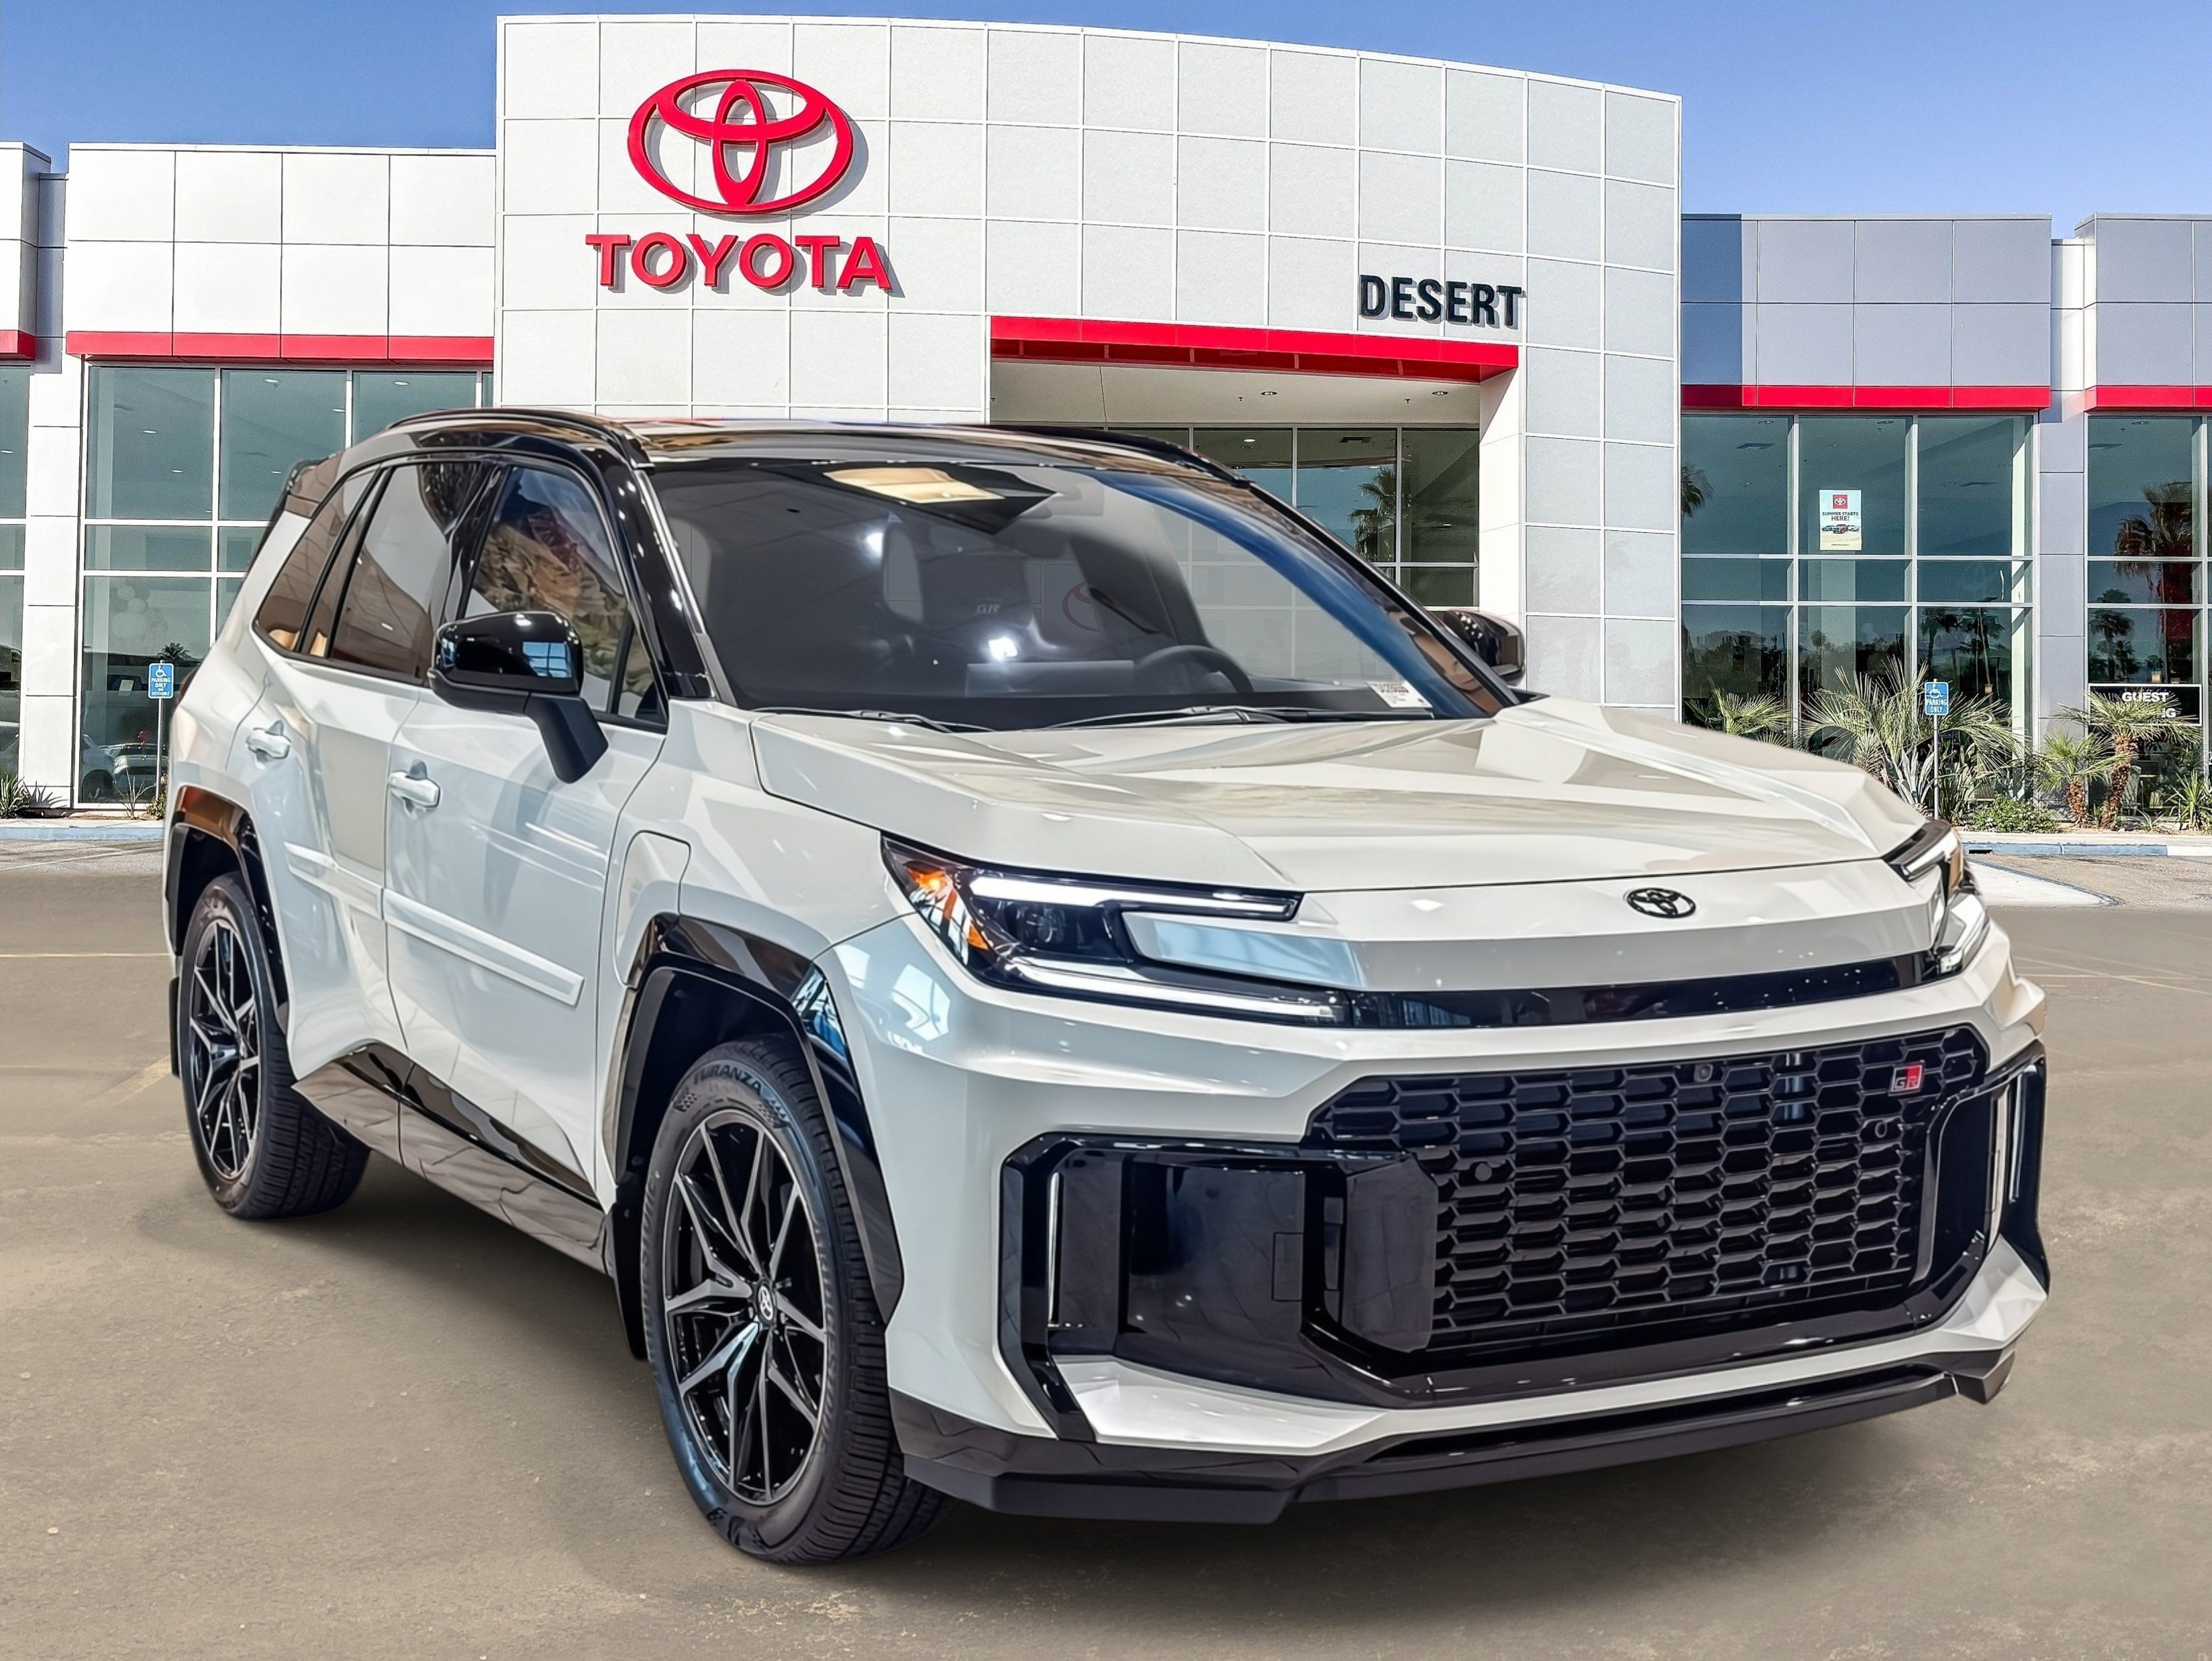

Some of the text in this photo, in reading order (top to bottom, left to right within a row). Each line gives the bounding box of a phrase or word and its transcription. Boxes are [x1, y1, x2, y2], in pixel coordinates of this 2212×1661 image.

[585, 232, 893, 292] TOYOTA
[1359, 274, 1522, 326] DESERT
[976, 604, 1001, 613] GR
[2121, 692, 2169, 702] GUEST
[1895, 1076, 1918, 1092] GR
